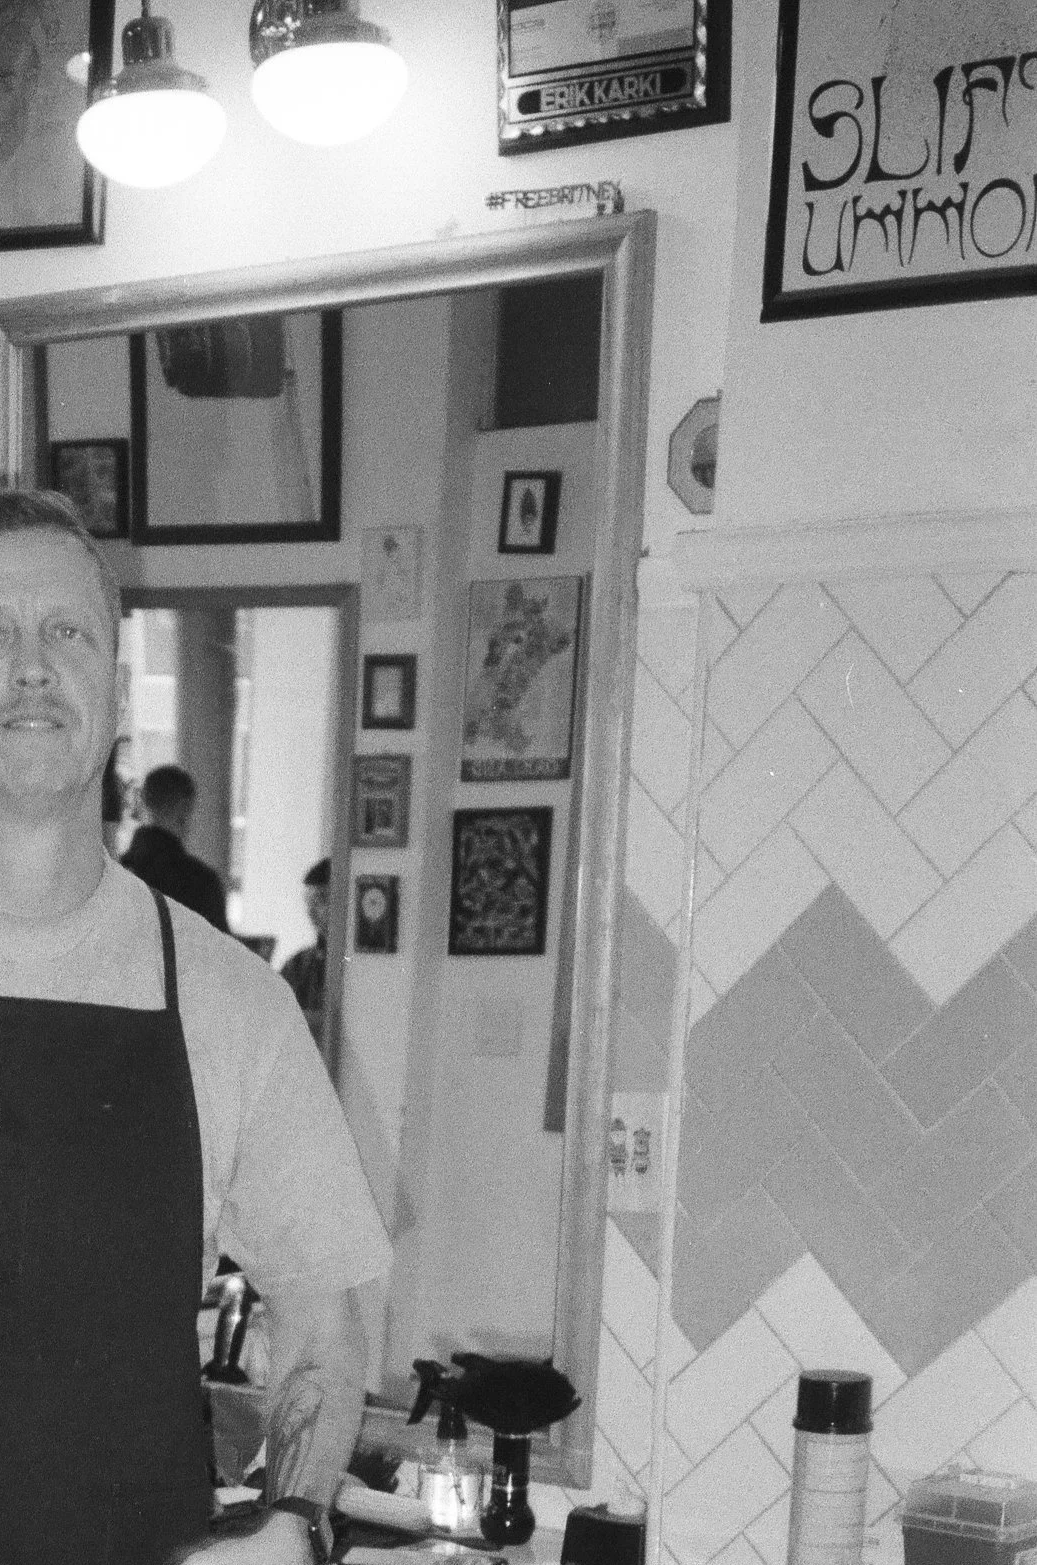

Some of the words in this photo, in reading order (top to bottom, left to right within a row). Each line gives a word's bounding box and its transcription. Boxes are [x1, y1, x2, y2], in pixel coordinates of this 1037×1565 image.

[541, 82, 591, 112] ERIK
[593, 72, 661, 107] KARKI
[484, 181, 622, 210] #FREEBRITNEY
